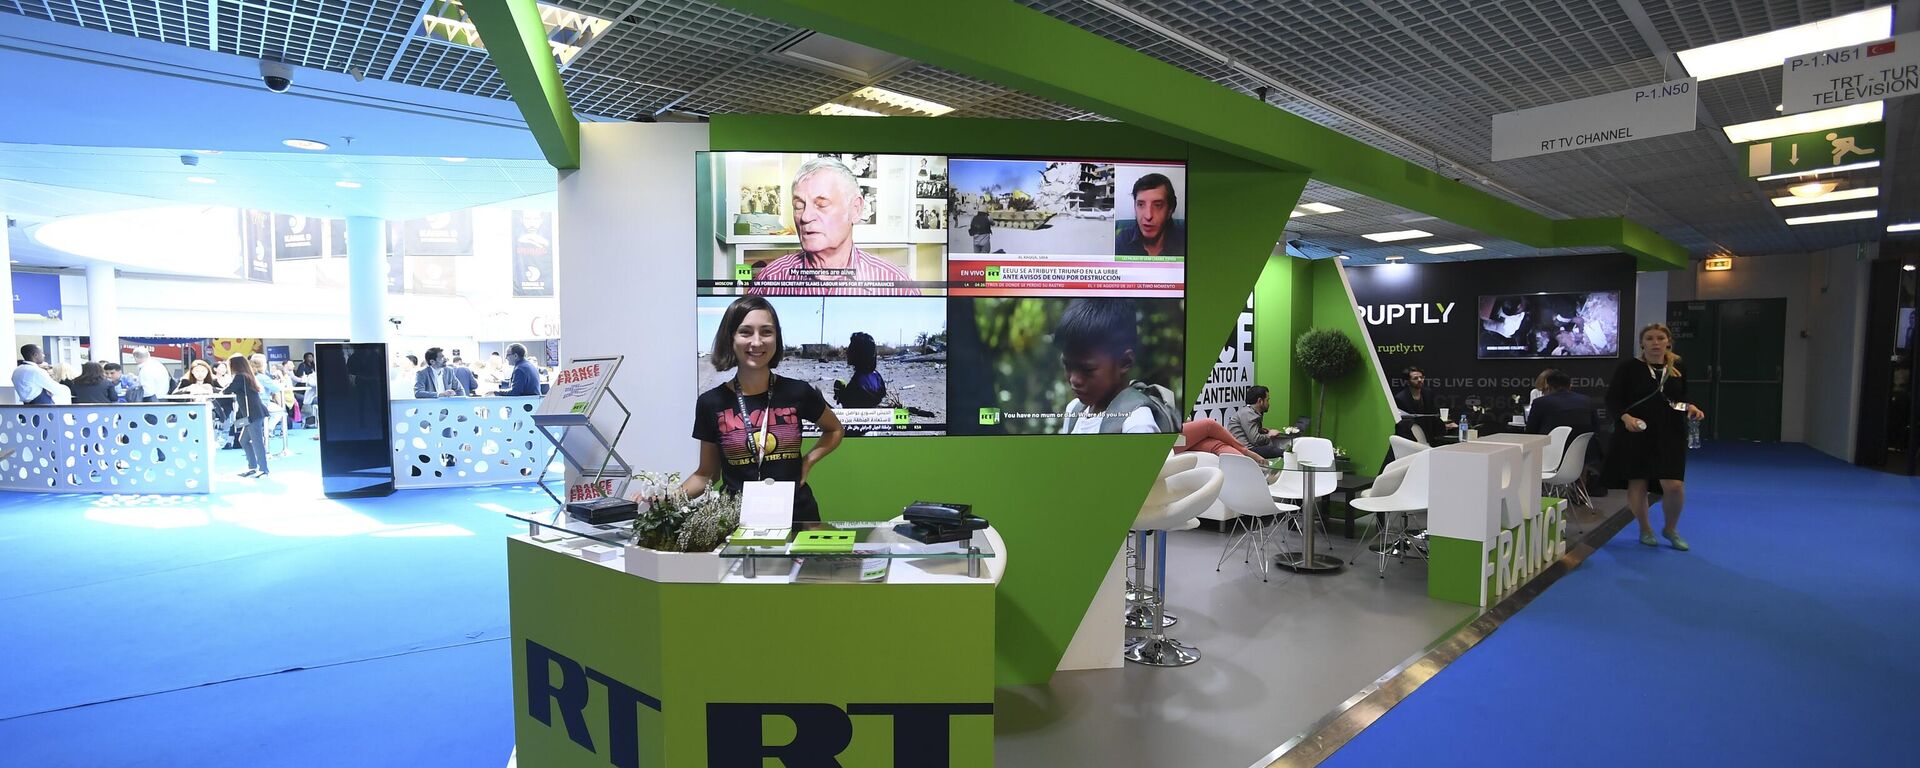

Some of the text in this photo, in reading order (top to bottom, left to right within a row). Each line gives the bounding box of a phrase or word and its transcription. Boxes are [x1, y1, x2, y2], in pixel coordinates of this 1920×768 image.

[1792, 48, 1859, 72] P-1.N51
[1635, 82, 1690, 103] P-1.N50
[1813, 77, 1918, 105] TELEVISION
[1830, 74, 1864, 90] TRT
[1541, 127, 1634, 151] RT TV CHANNEL
[1377, 342, 1425, 354] ruptly.tv
[1241, 366, 1248, 382] A
[1444, 378, 1473, 387] LIVE
[1477, 378, 1497, 387] ON
[1479, 499, 1568, 607] FRANCE
[526, 638, 662, 768] RT
[706, 703, 994, 768] RT
